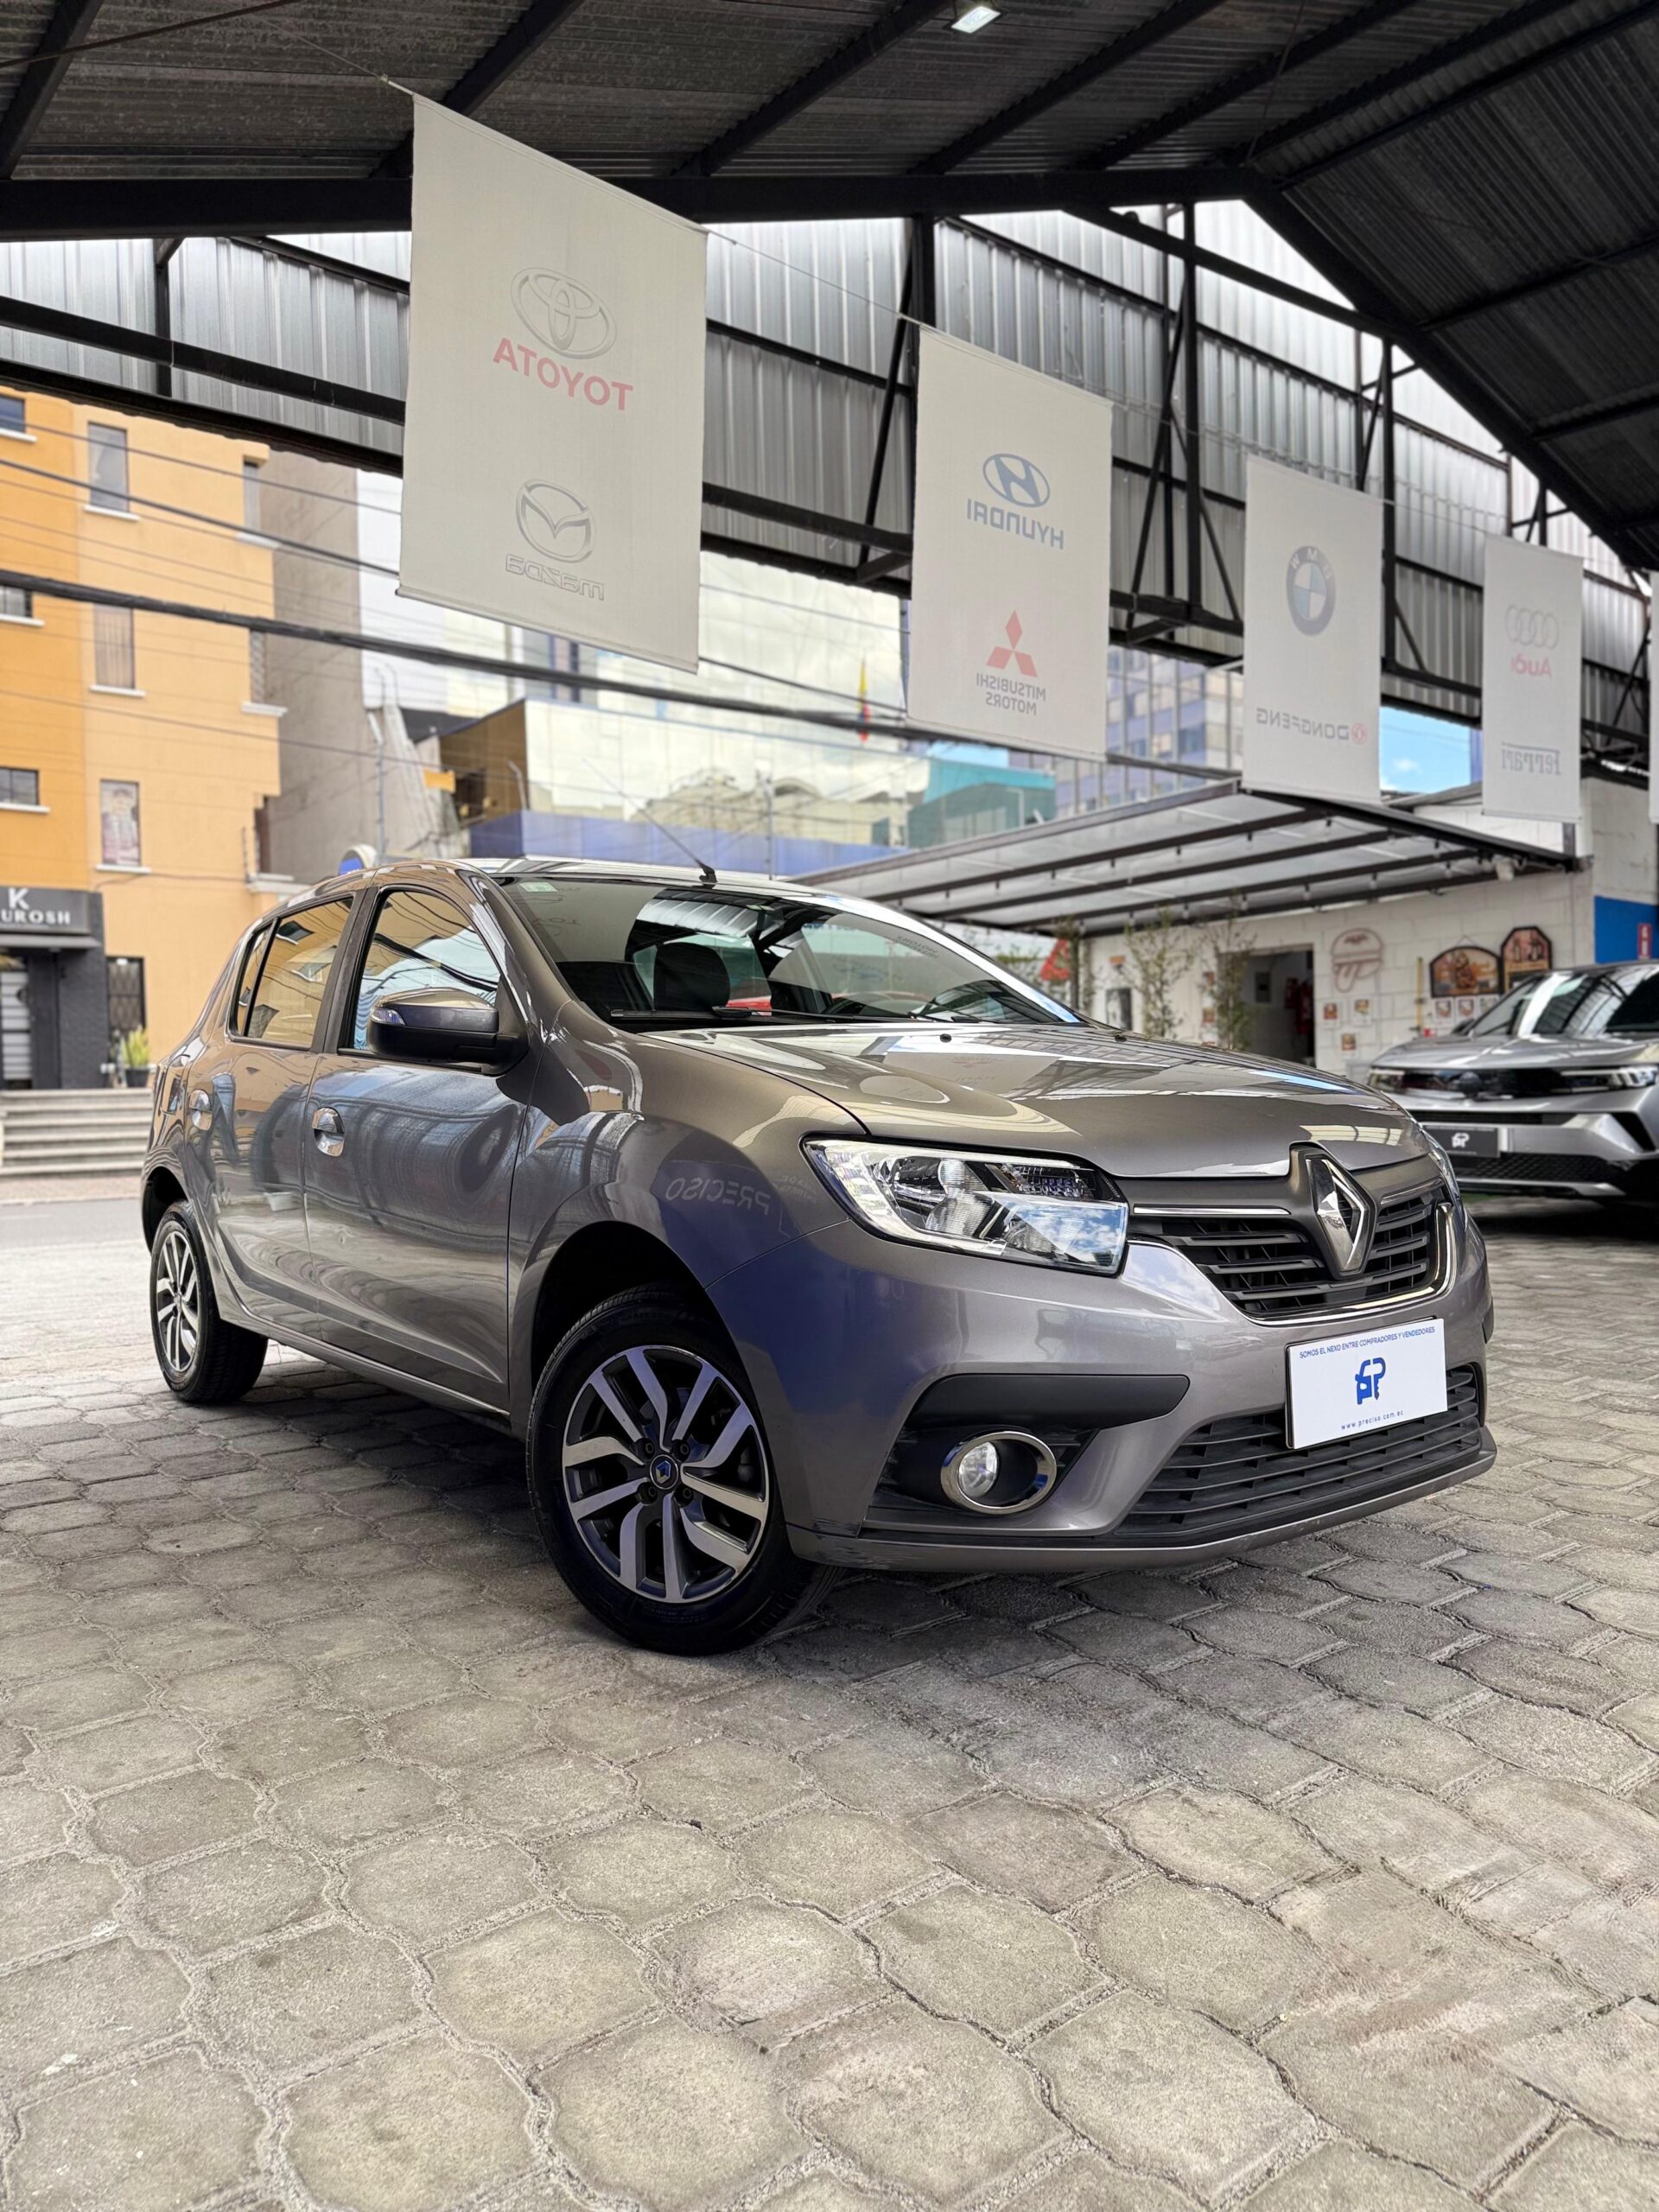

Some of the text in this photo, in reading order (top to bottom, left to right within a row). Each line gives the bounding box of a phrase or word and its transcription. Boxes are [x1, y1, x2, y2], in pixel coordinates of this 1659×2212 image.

[8, 887, 29, 909] K
[1300, 1349, 1319, 1358] SOMOS
[1326, 1344, 1341, 1353] NEXO
[1342, 1340, 1358, 1350] ENTRE
[1359, 1333, 1398, 1347] COMPRADORES
[1402, 1326, 1435, 1338] VENDEDORES
